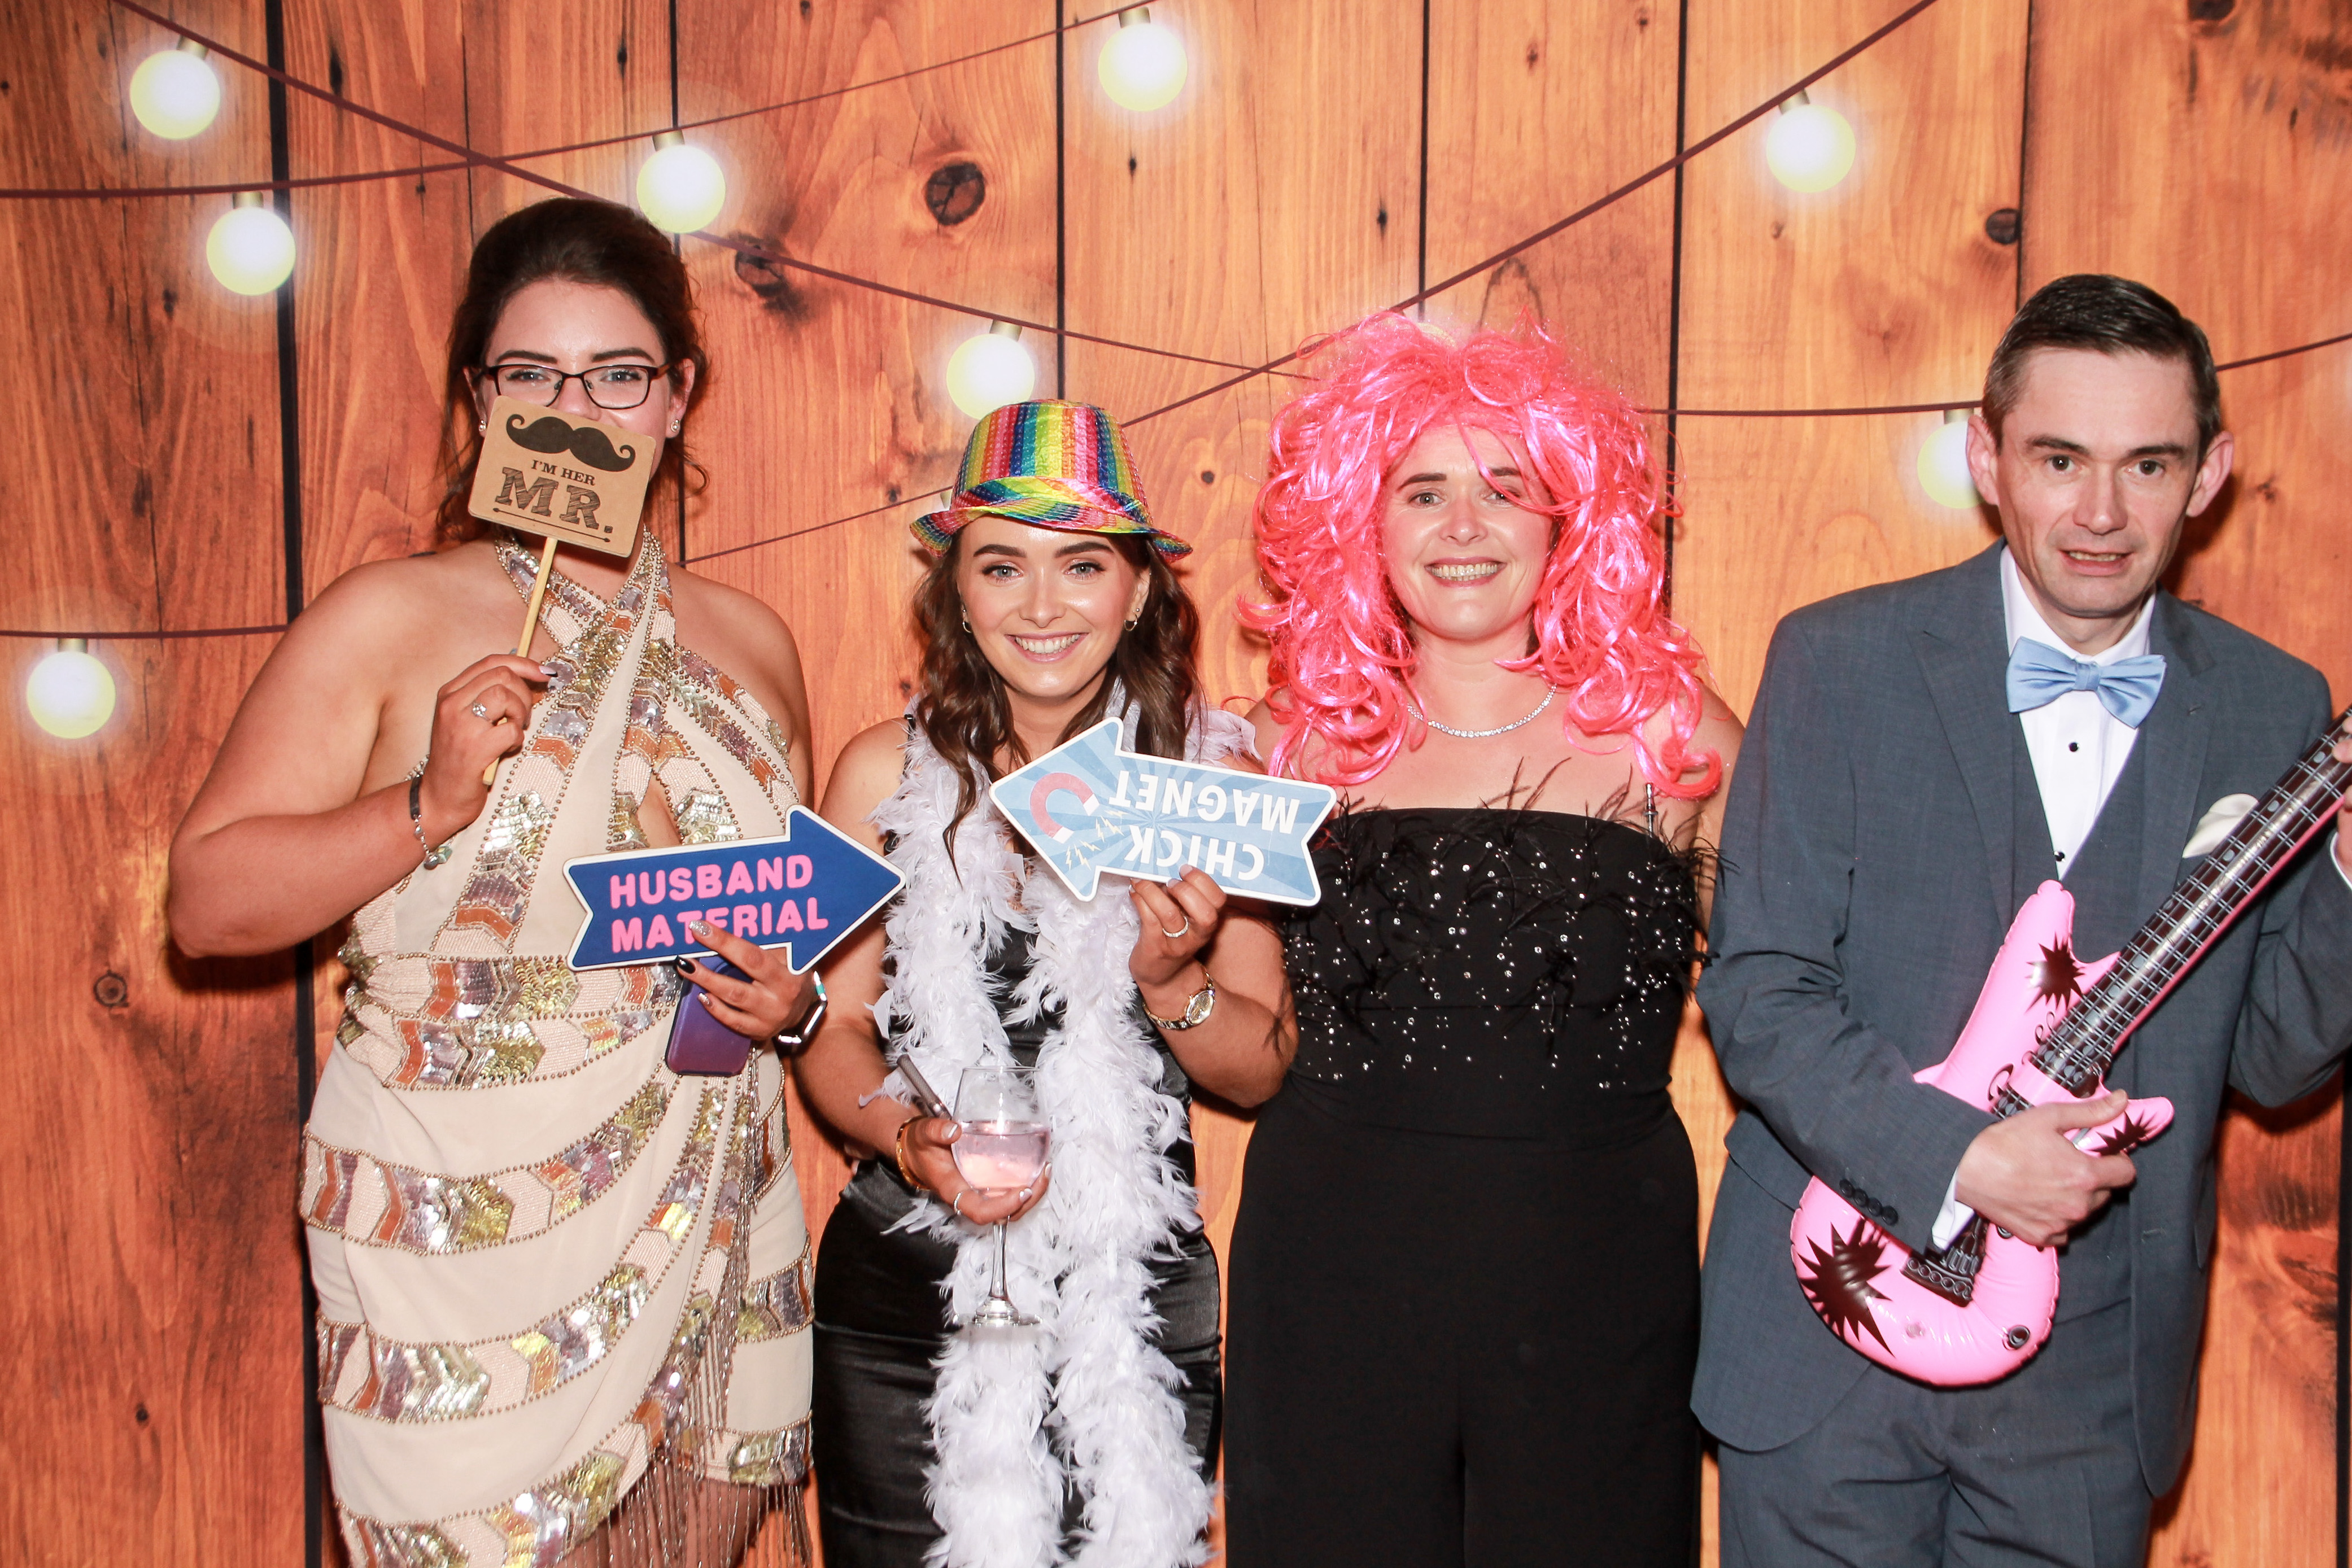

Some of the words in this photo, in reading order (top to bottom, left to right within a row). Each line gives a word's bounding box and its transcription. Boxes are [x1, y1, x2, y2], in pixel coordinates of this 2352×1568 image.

[495, 466, 613, 534] MR.
[531, 460, 556, 475] I'M
[561, 468, 595, 486] HER
[1109, 770, 1299, 835] MAGNET
[1124, 826, 1264, 880] CHICK
[610, 854, 813, 909] HUSBAND
